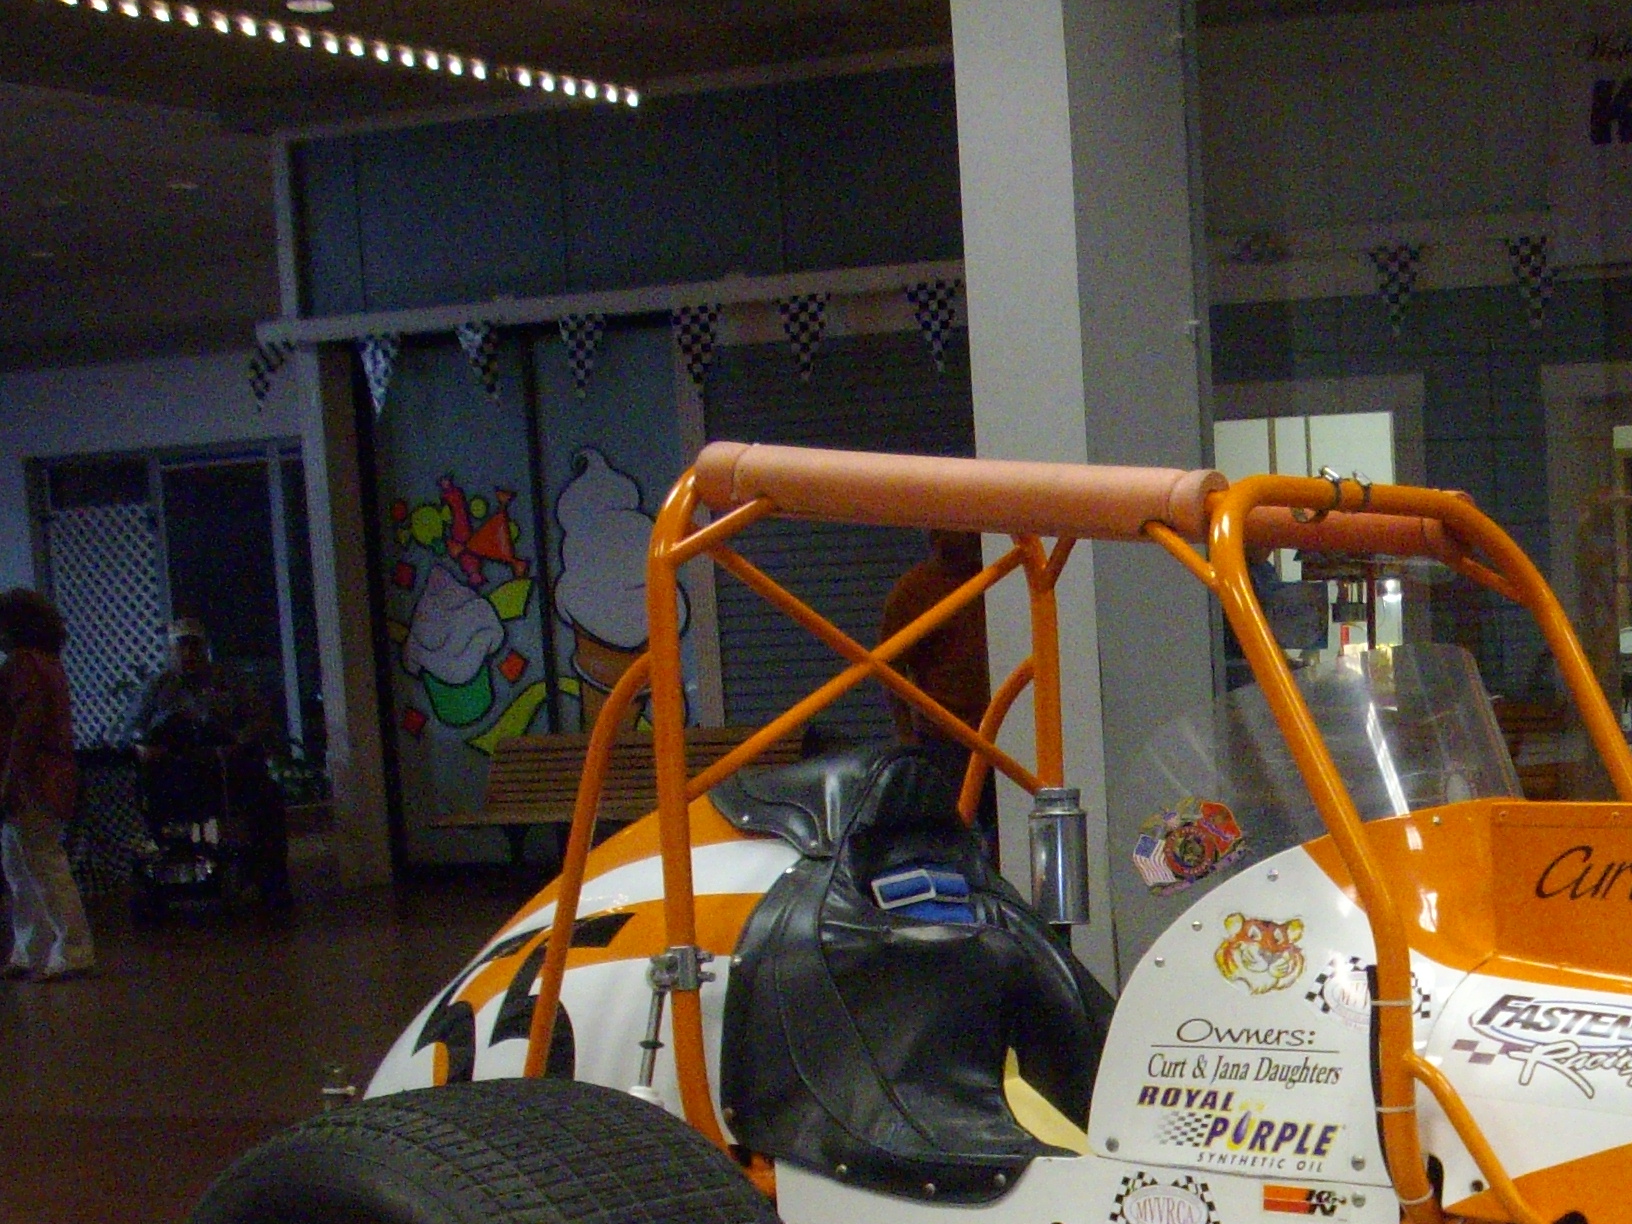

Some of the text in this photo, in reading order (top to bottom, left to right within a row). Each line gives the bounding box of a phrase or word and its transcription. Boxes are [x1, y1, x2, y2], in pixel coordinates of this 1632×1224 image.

[1176, 1018, 1316, 1046] Owners:
[1148, 1053, 1343, 1089] Curt & Jana Daughters
[1137, 1085, 1236, 1112] ROYAL
[1203, 1111, 1339, 1156] PURPLE
[1197, 1152, 1324, 1173] SYNTHETIC OIL
